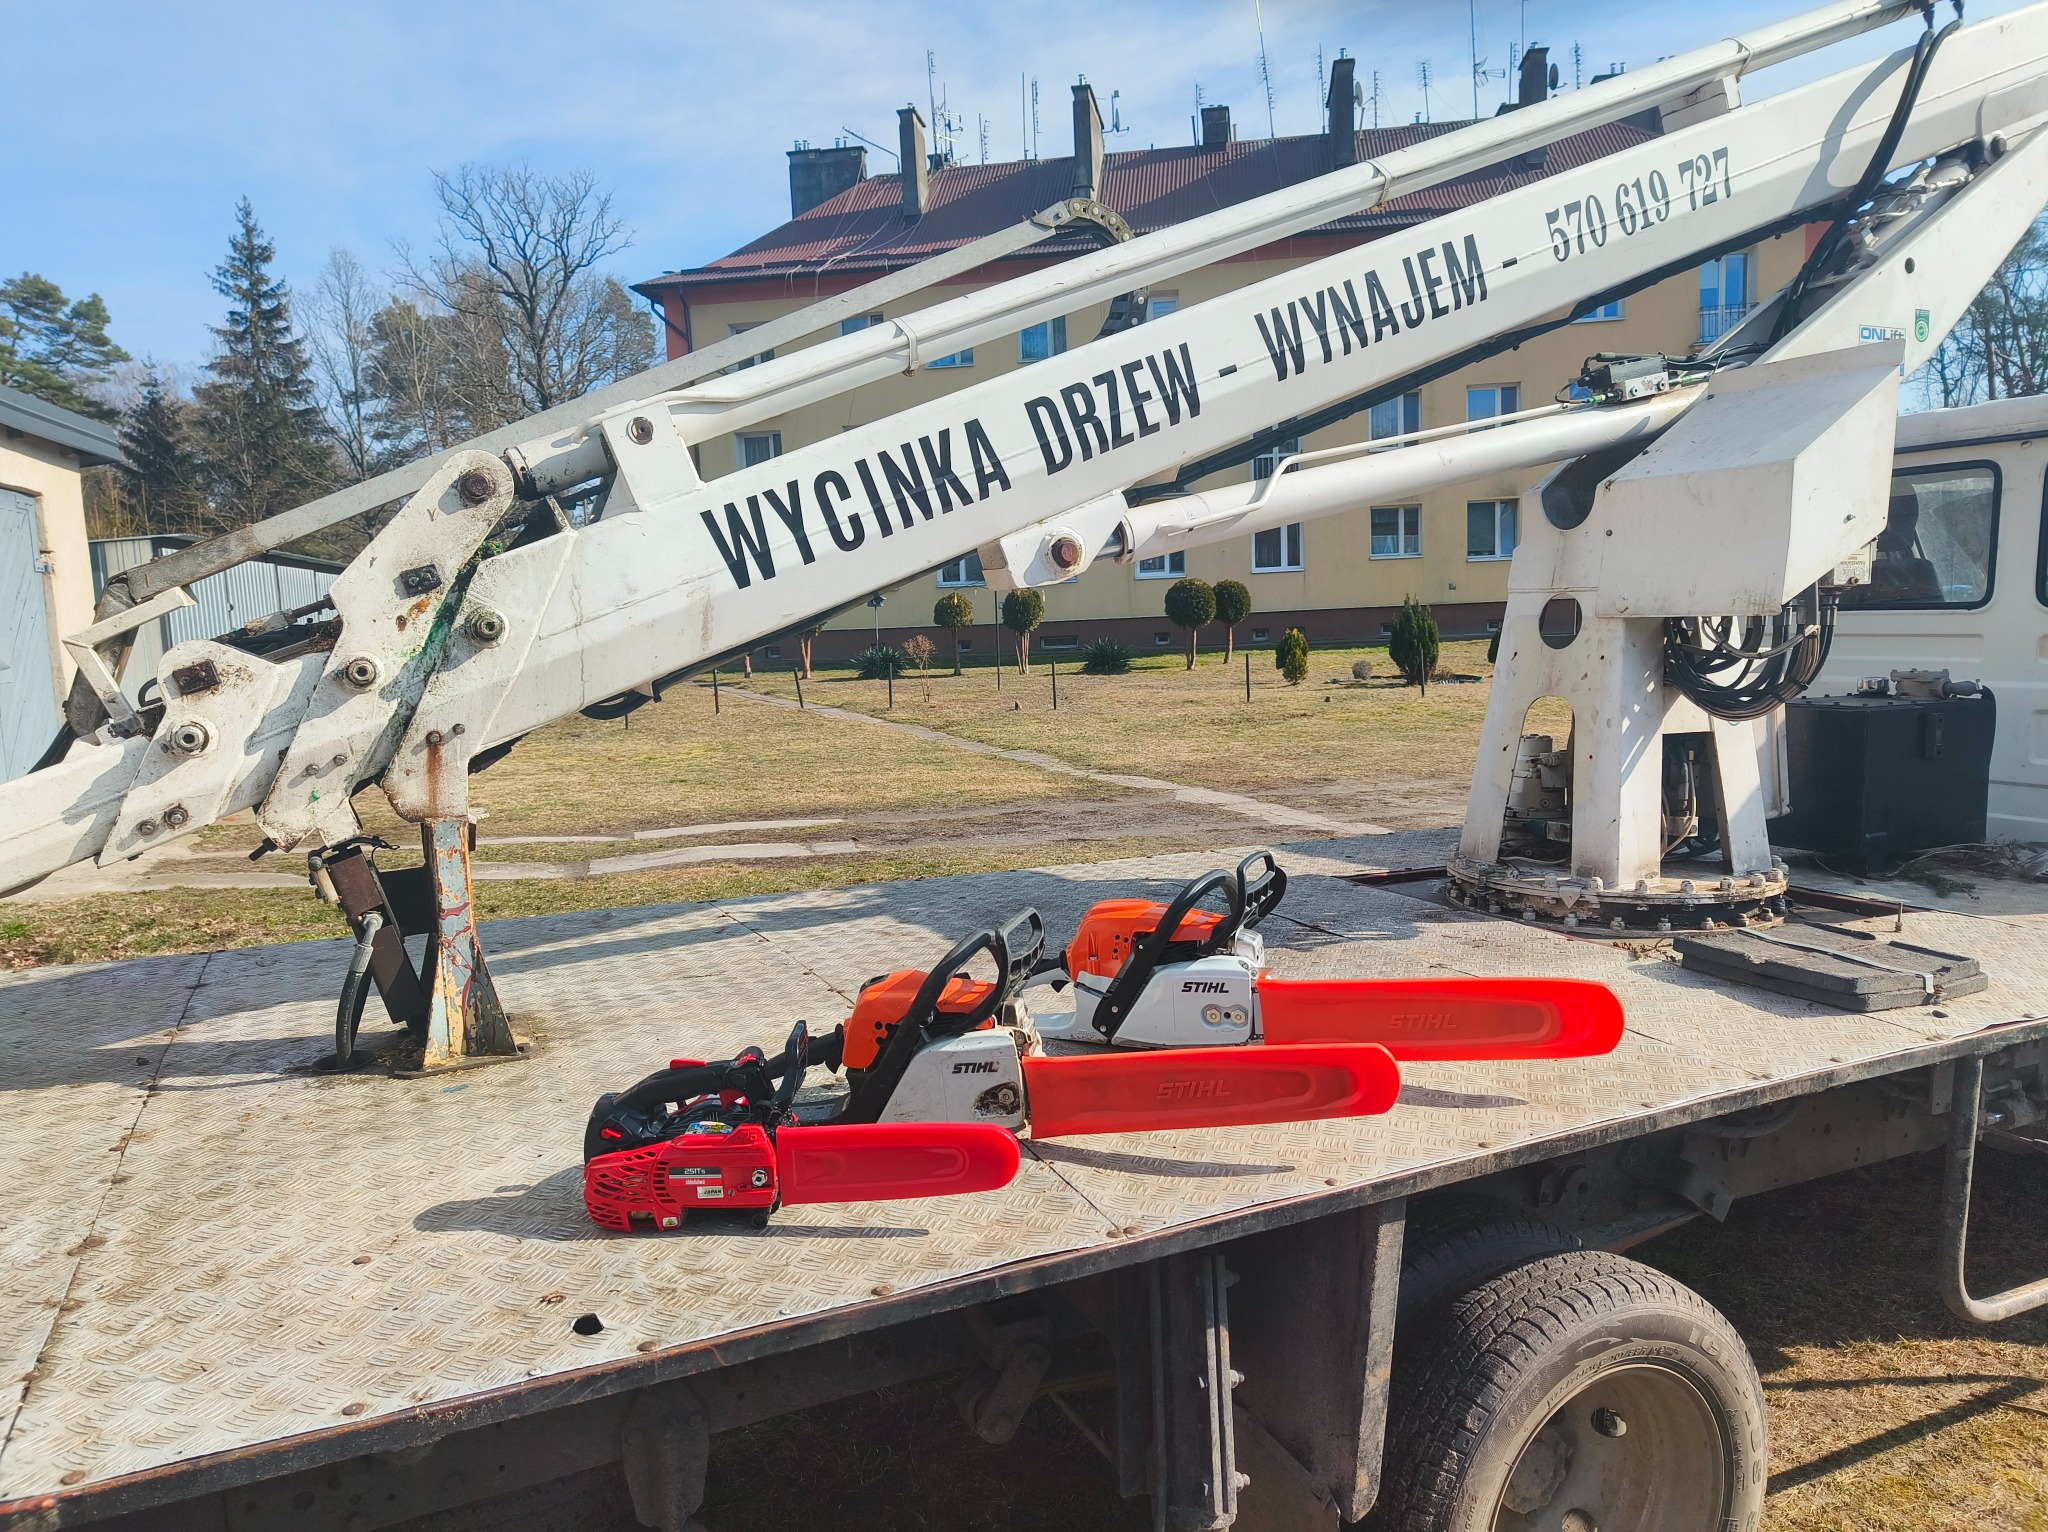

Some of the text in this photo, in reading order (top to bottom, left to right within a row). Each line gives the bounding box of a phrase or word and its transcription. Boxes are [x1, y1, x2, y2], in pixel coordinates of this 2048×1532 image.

[1861, 327, 1904, 341] ONLift
[700, 418, 1011, 589] WYCINKA
[1024, 342, 1201, 476] DRZEW
[1254, 234, 1488, 382] WYNAJEM
[1545, 194, 1608, 262] 570
[1614, 169, 1671, 236] 619
[1679, 147, 1732, 212] 727
[1181, 981, 1230, 993] STIHL
[1388, 1011, 1459, 1030] STIHL
[952, 1061, 1000, 1074] STIHL
[1156, 1079, 1232, 1100] STIHL
